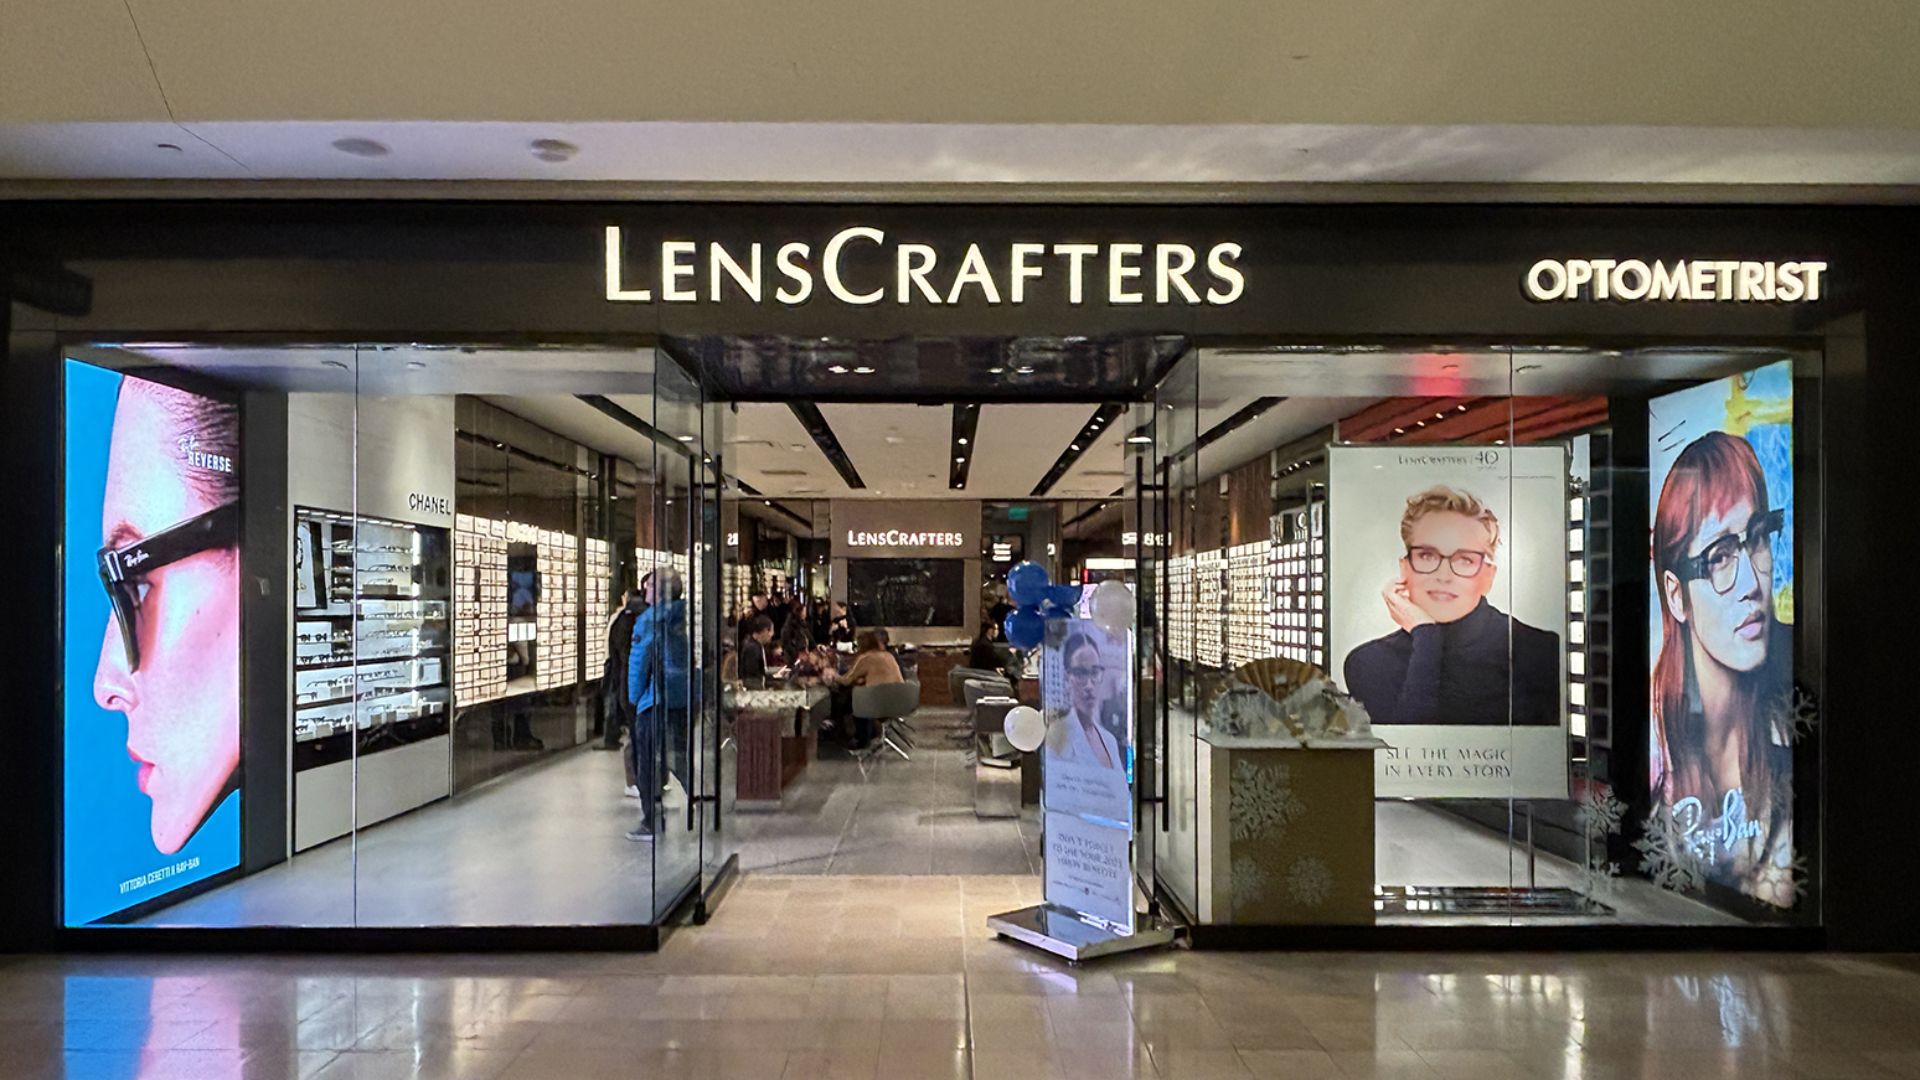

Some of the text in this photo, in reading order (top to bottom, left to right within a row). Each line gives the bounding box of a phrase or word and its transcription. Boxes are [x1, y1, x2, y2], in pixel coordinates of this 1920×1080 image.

[606, 226, 1245, 304] LENSCRAFTERS
[1527, 258, 1828, 302] OPTOMETRIST
[188, 451, 232, 473] REVERSE
[409, 493, 451, 515] CHANEL
[1421, 748, 1447, 760] THE
[1459, 748, 1509, 761] MAGIC
[1384, 764, 1511, 777] IN EVERY STORY
